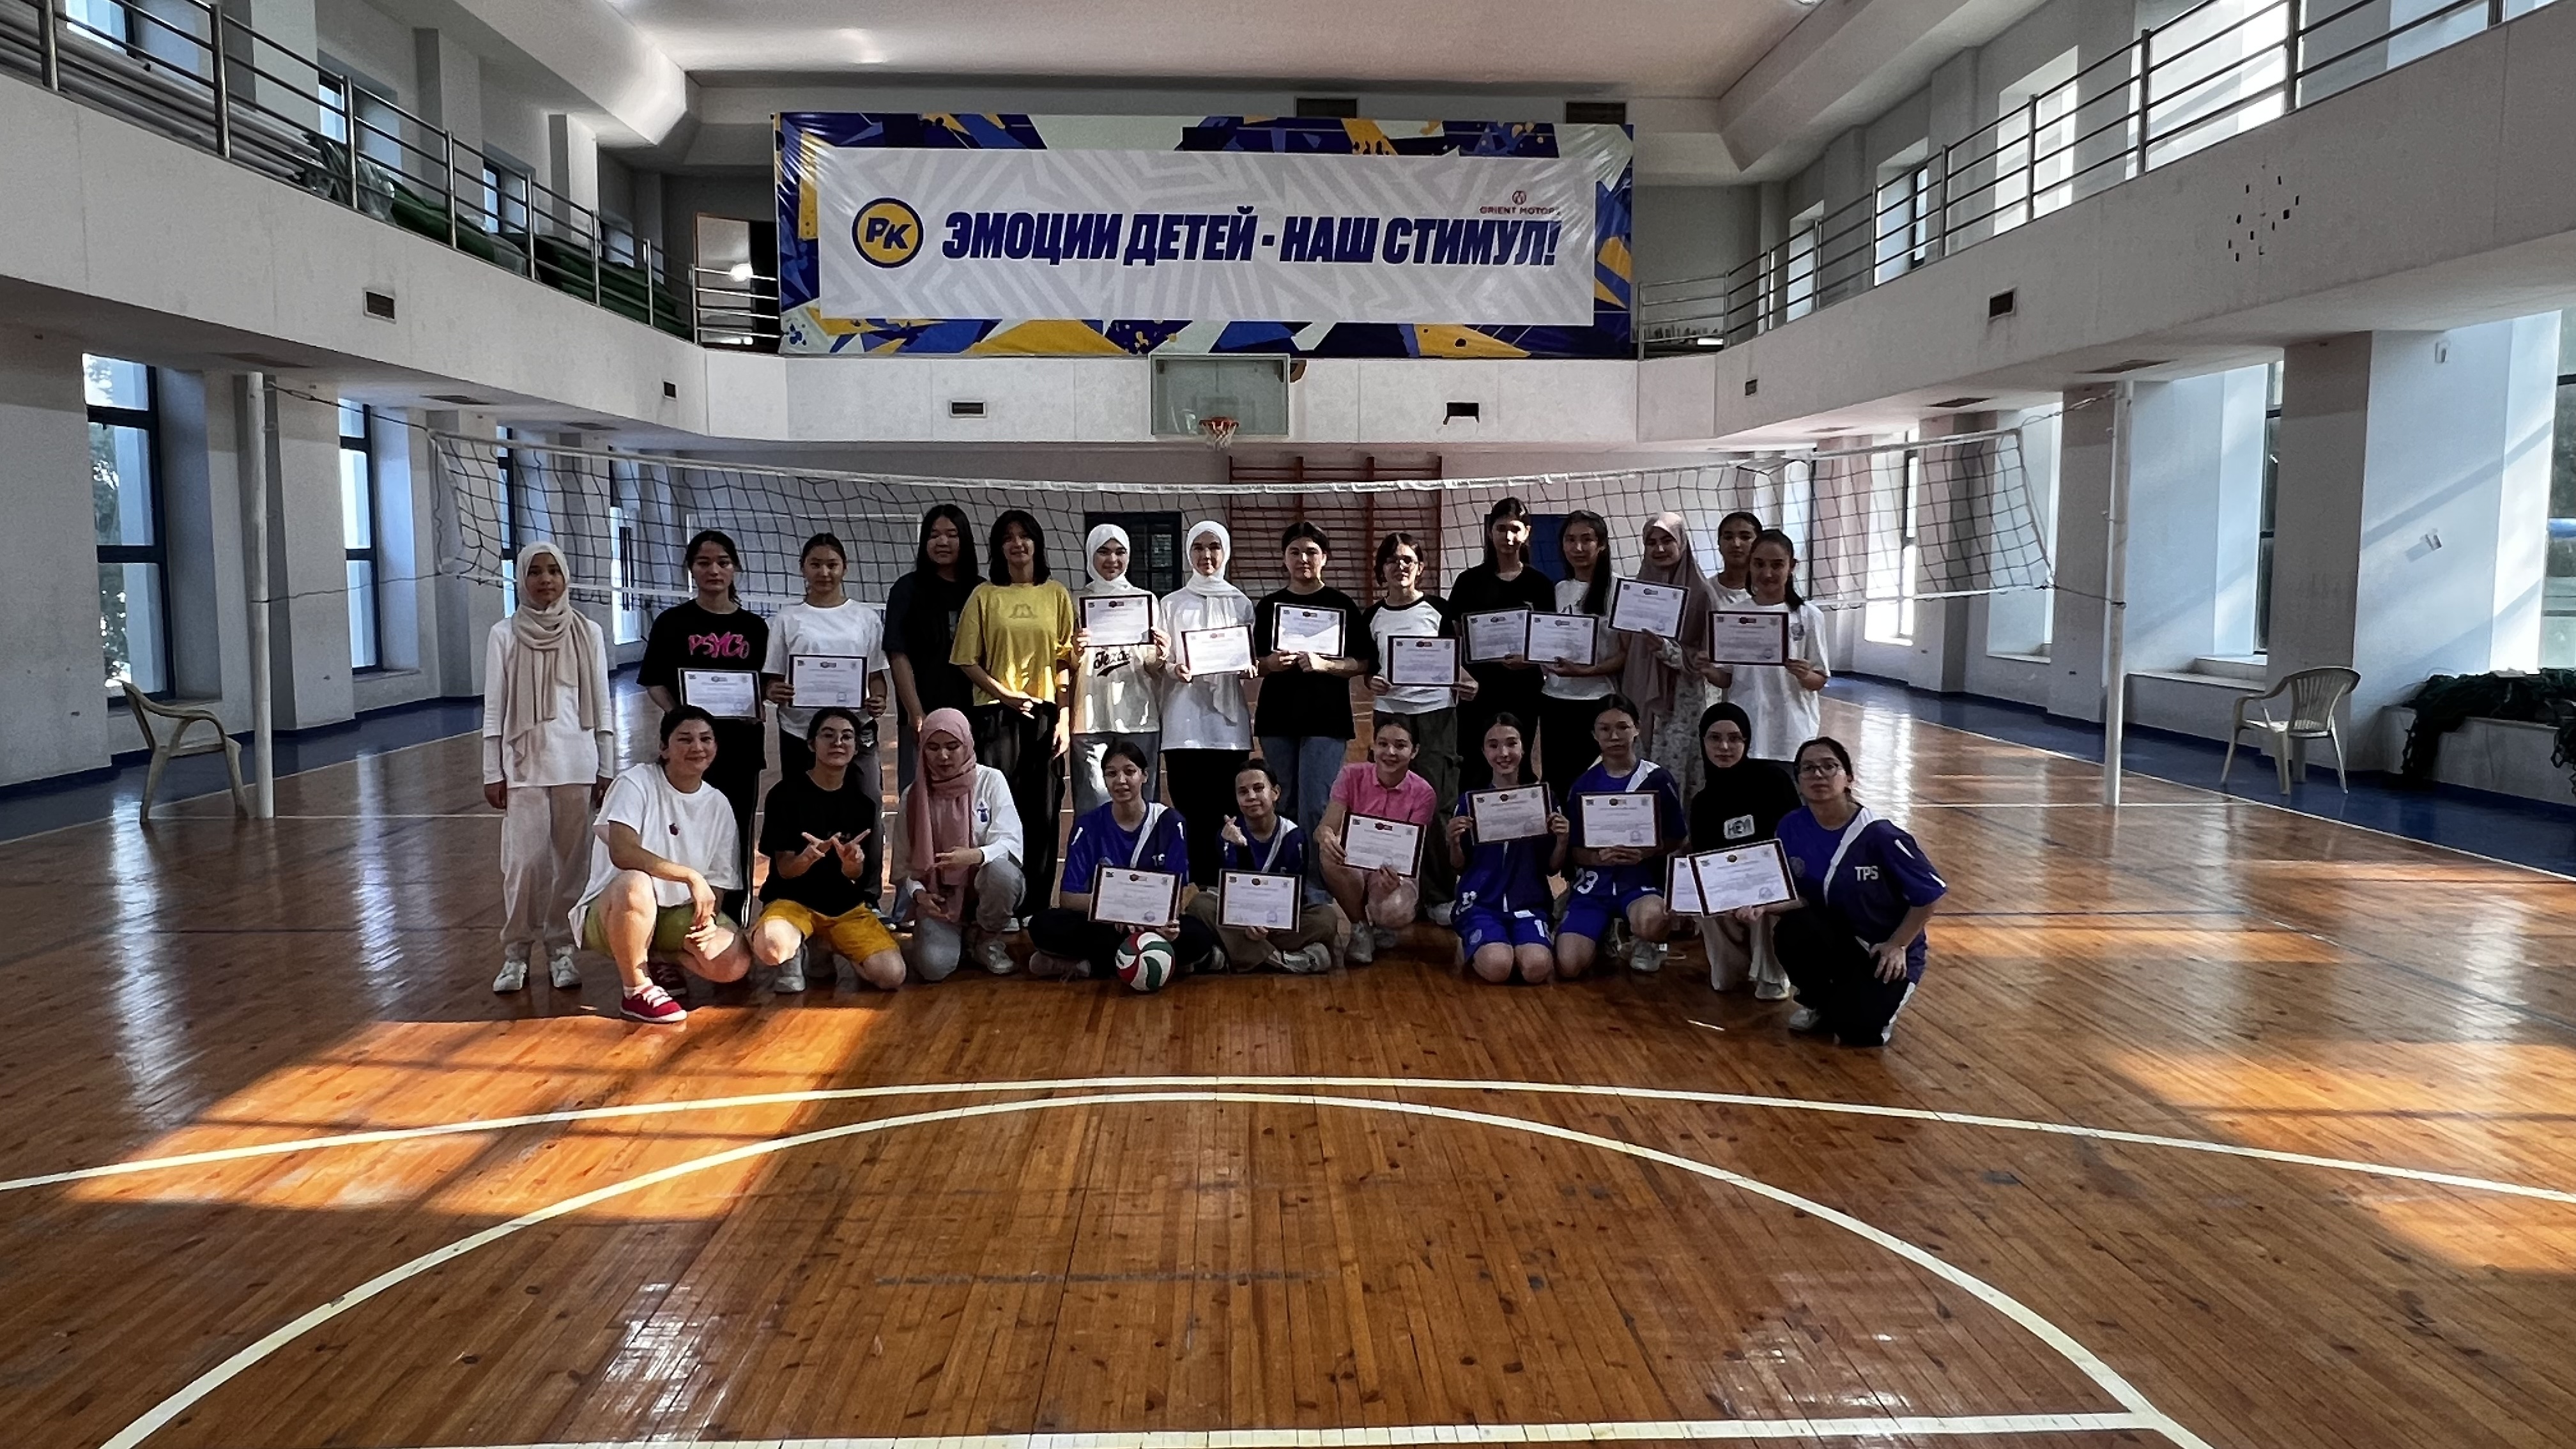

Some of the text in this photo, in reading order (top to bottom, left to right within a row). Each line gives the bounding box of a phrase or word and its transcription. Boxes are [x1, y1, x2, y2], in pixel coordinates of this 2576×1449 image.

[1480, 206, 1517, 215] ORIENT
[942, 211, 1123, 265] ЭМОЦИИ
[1123, 206, 1258, 266] ДЕТЕЙ
[1280, 217, 1379, 263] НАШ
[1383, 218, 1562, 265] СТИМУЛ!
[1855, 866, 1878, 881] TPS
